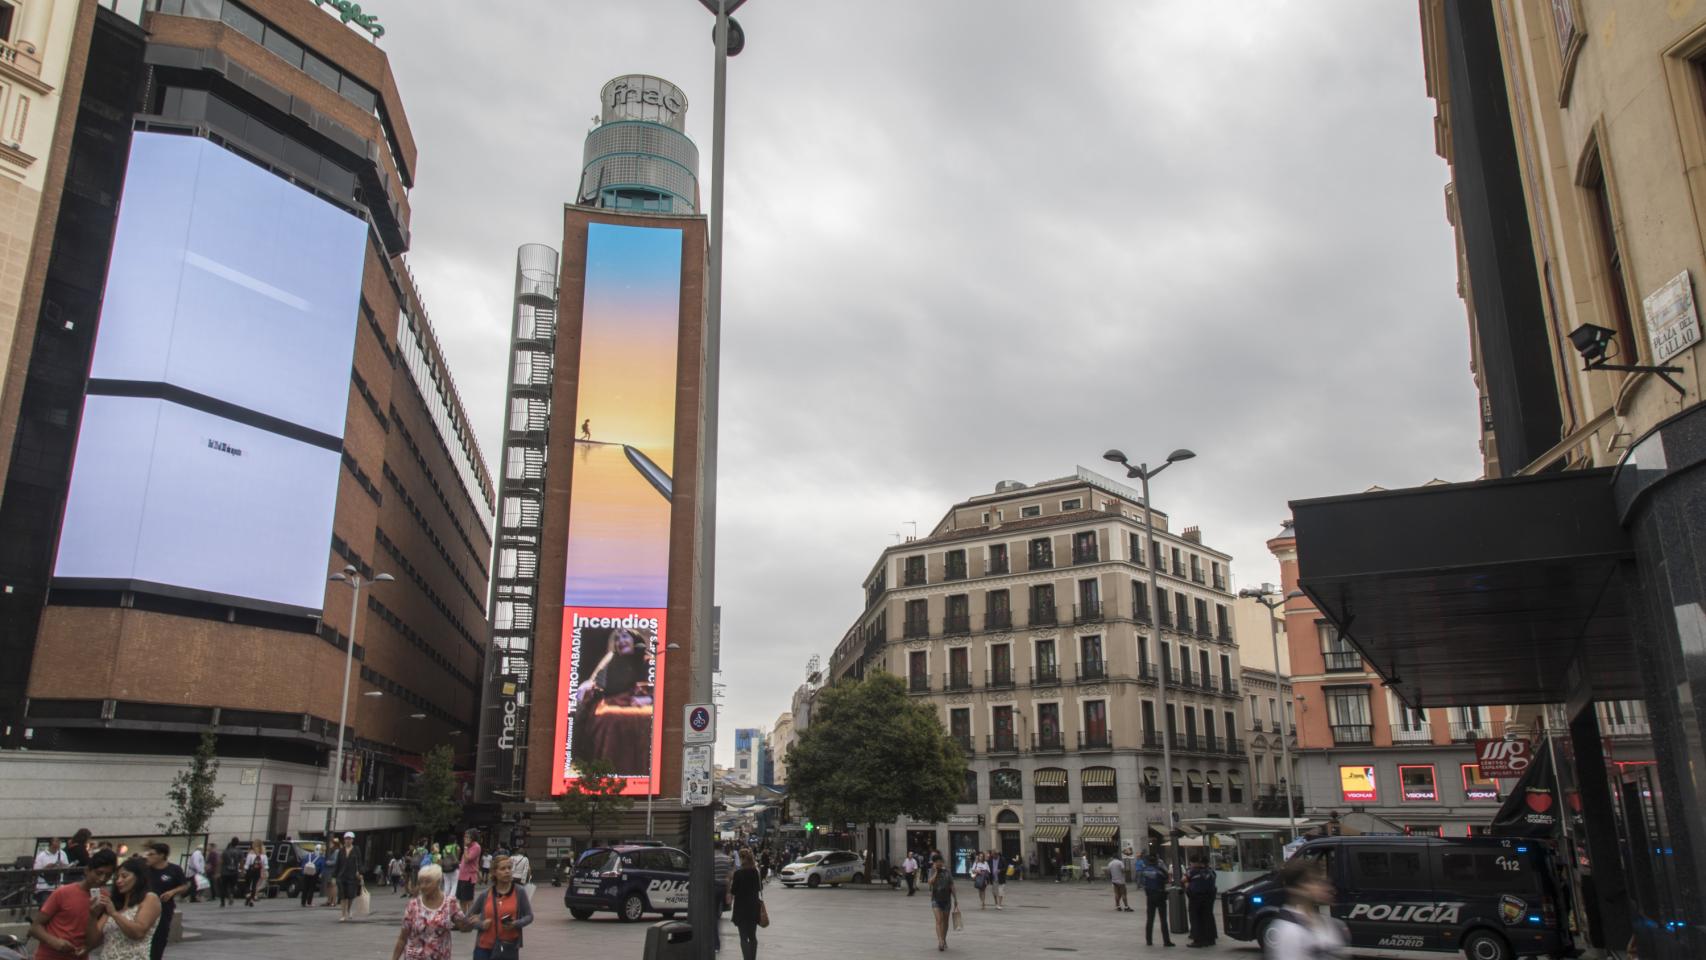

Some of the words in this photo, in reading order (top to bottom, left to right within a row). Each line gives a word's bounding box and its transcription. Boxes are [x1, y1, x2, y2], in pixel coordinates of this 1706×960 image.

[611, 82, 681, 114] fnac
[1653, 327, 1677, 349] PLAZA
[1680, 317, 1695, 330] DEL
[1659, 328, 1695, 360] CALLAO
[573, 613, 658, 629] Incendios
[571, 627, 582, 667] ABADÍA
[568, 671, 579, 713] TEATRO
[498, 701, 516, 749] fnac
[1502, 860, 1520, 871] 112
[1349, 902, 1461, 923] POLICÍA
[1378, 938, 1425, 947] MADRID
